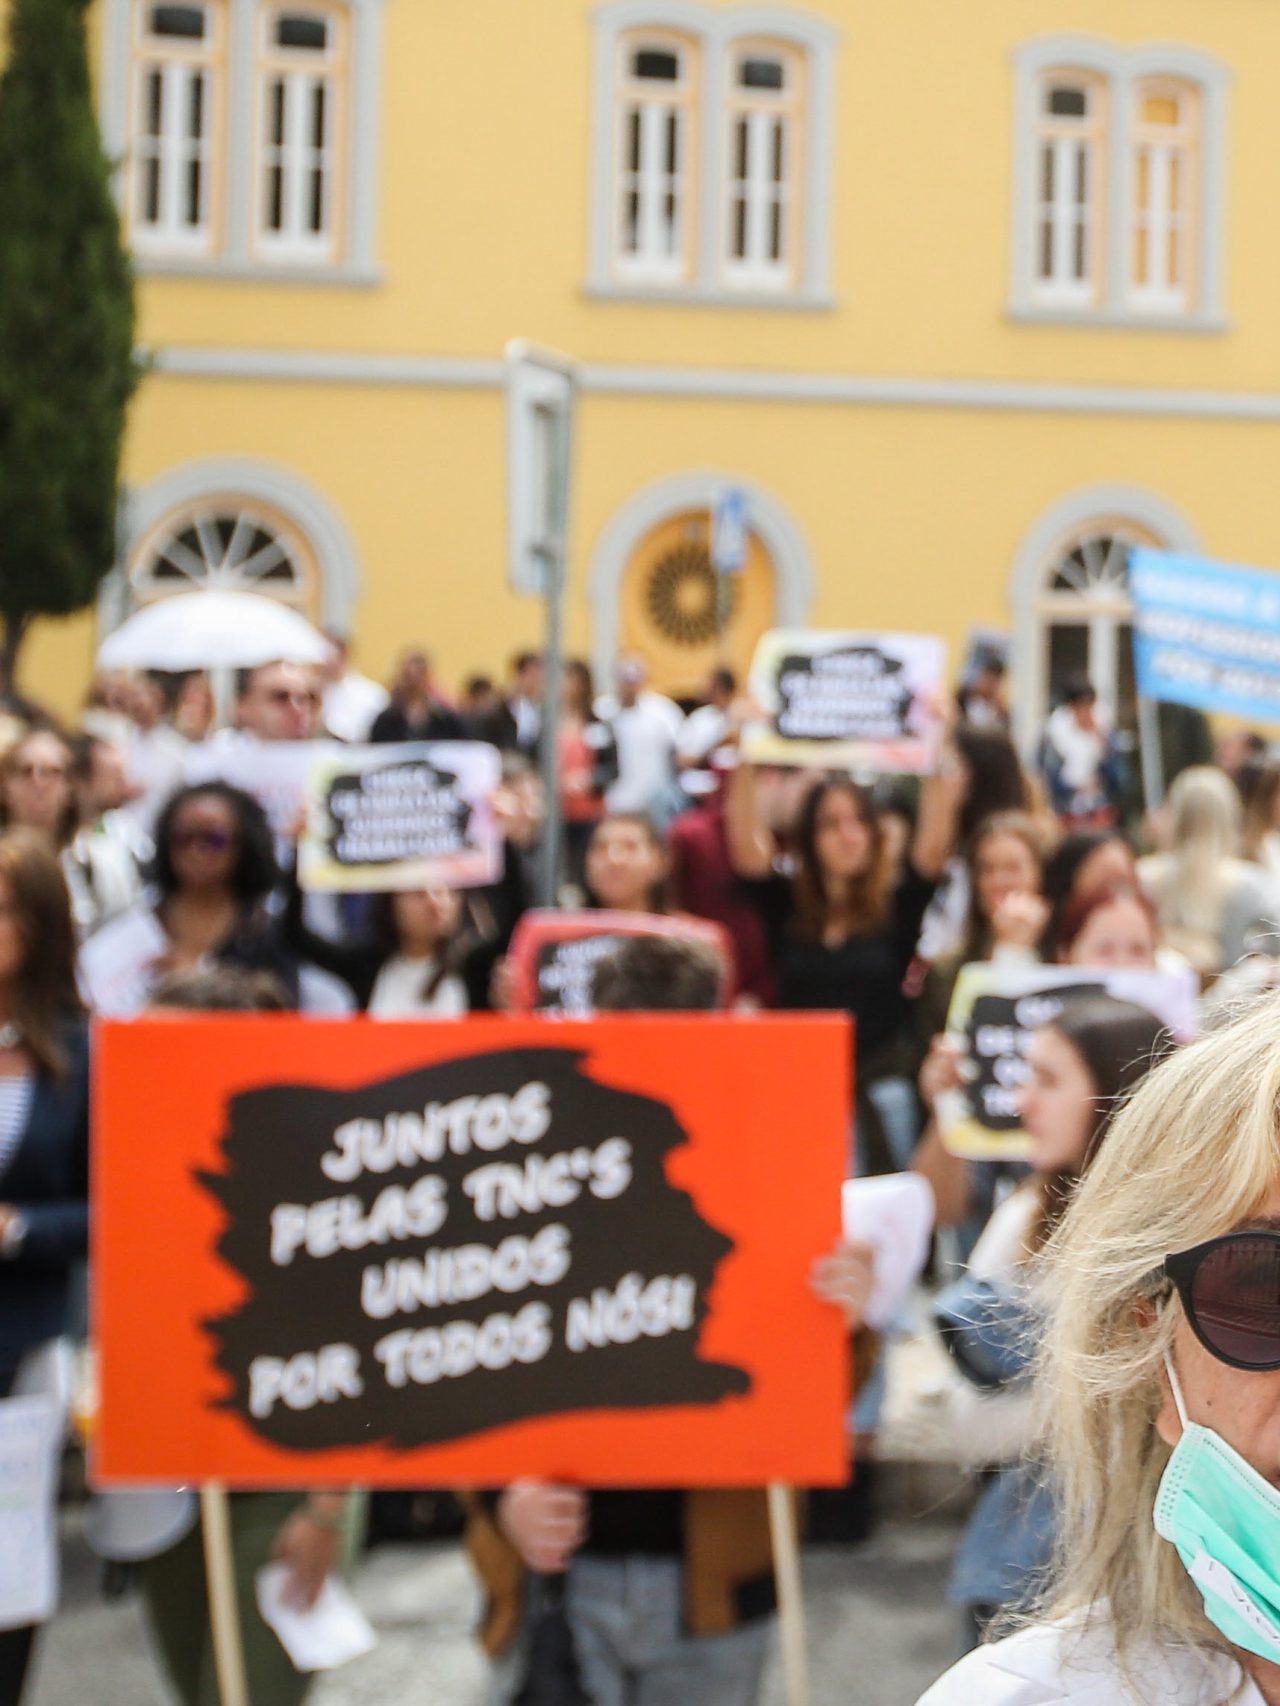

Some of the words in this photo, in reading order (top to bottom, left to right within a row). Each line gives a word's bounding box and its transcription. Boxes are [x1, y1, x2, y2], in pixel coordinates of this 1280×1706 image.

[320, 1081, 552, 1183] JUNTOS
[269, 1174, 448, 1266] PELAS
[461, 1137, 632, 1222] TNC'S
[360, 1223, 571, 1319] UNIDOS
[249, 1343, 363, 1417] POR
[374, 1301, 552, 1387] TODOS
